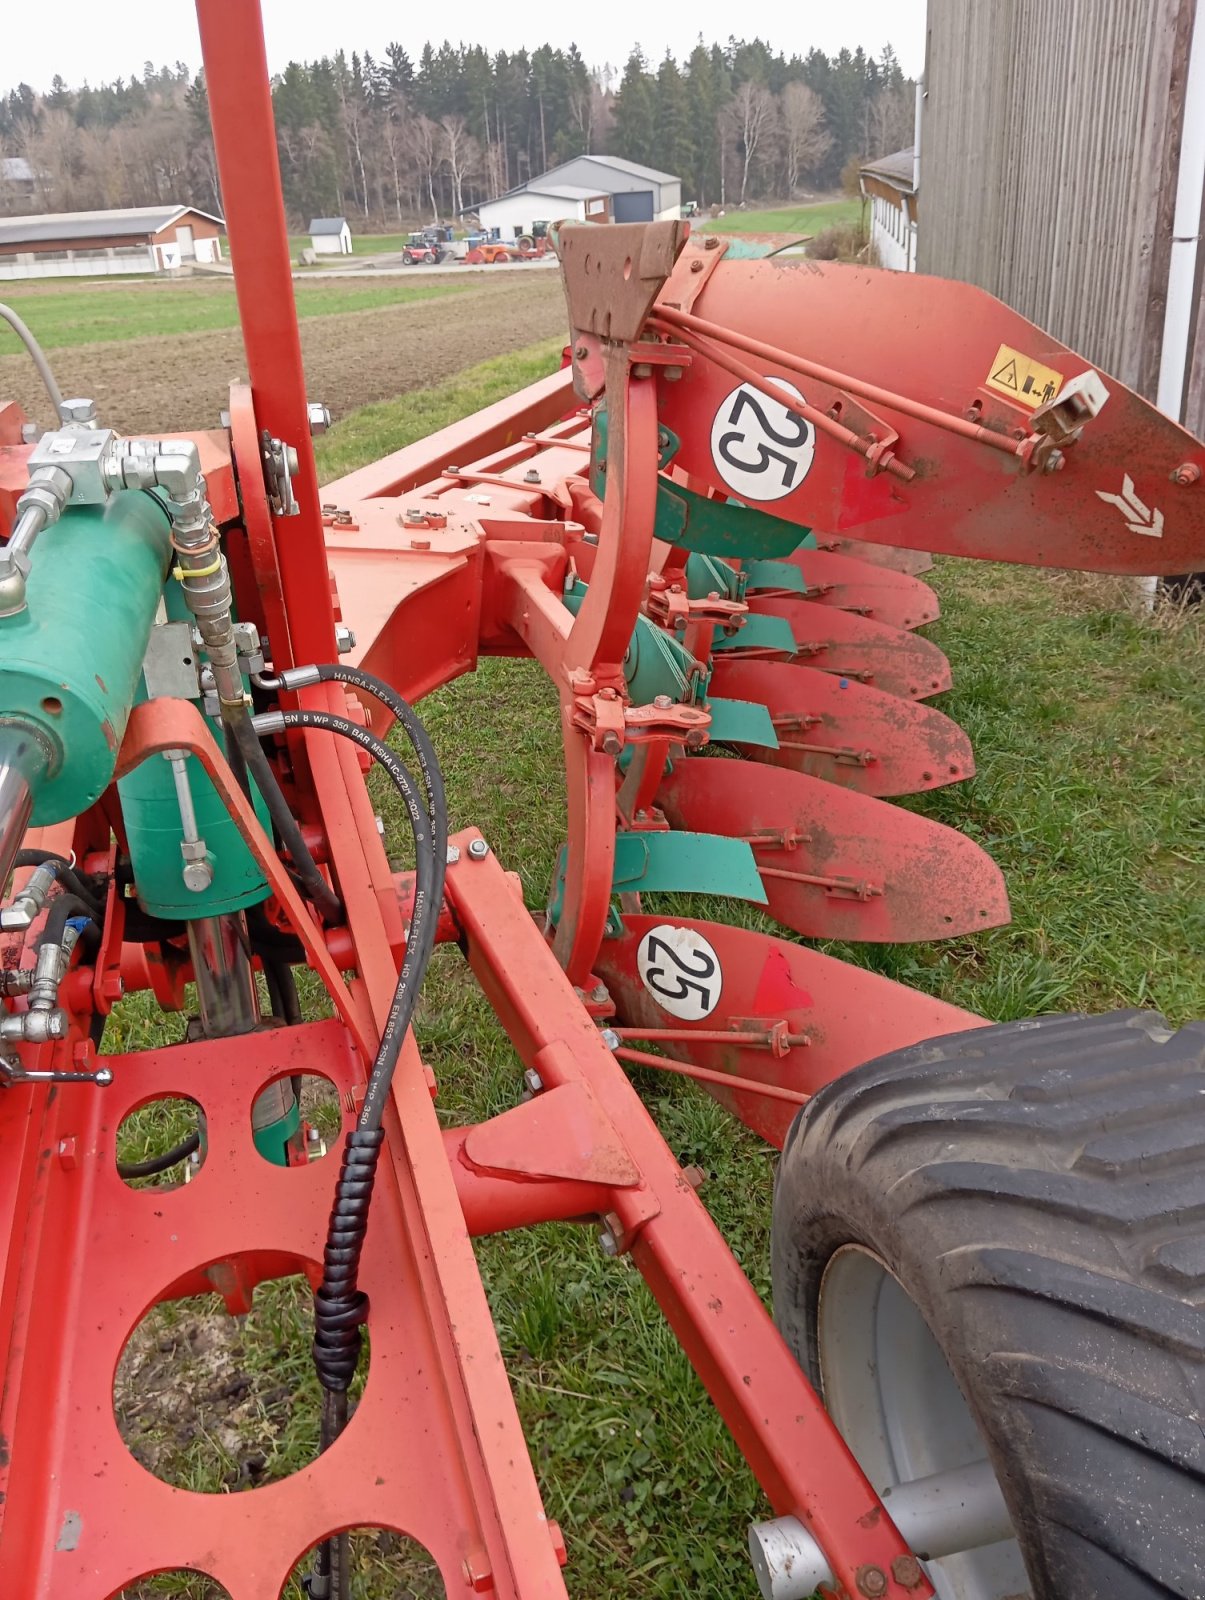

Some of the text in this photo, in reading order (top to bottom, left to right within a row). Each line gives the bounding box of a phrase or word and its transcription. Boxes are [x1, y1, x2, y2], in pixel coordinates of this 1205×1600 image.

[719, 390, 809, 489] 25
[334, 672, 390, 704] HANSA-FLEX
[313, 715, 329, 724] WP
[332, 720, 349, 731] 350
[351, 728, 371, 744] BAR
[371, 742, 393, 766] MSHA
[407, 891, 425, 956] HANSA-FLEX
[402, 963, 412, 978] HD
[645, 935, 715, 1011] 25
[395, 982, 406, 1000] 208
[390, 1004, 400, 1019] EN
[385, 1021, 395, 1039] 853
[377, 1044, 389, 1066] 2SN
[360, 1105, 371, 1125] 350
